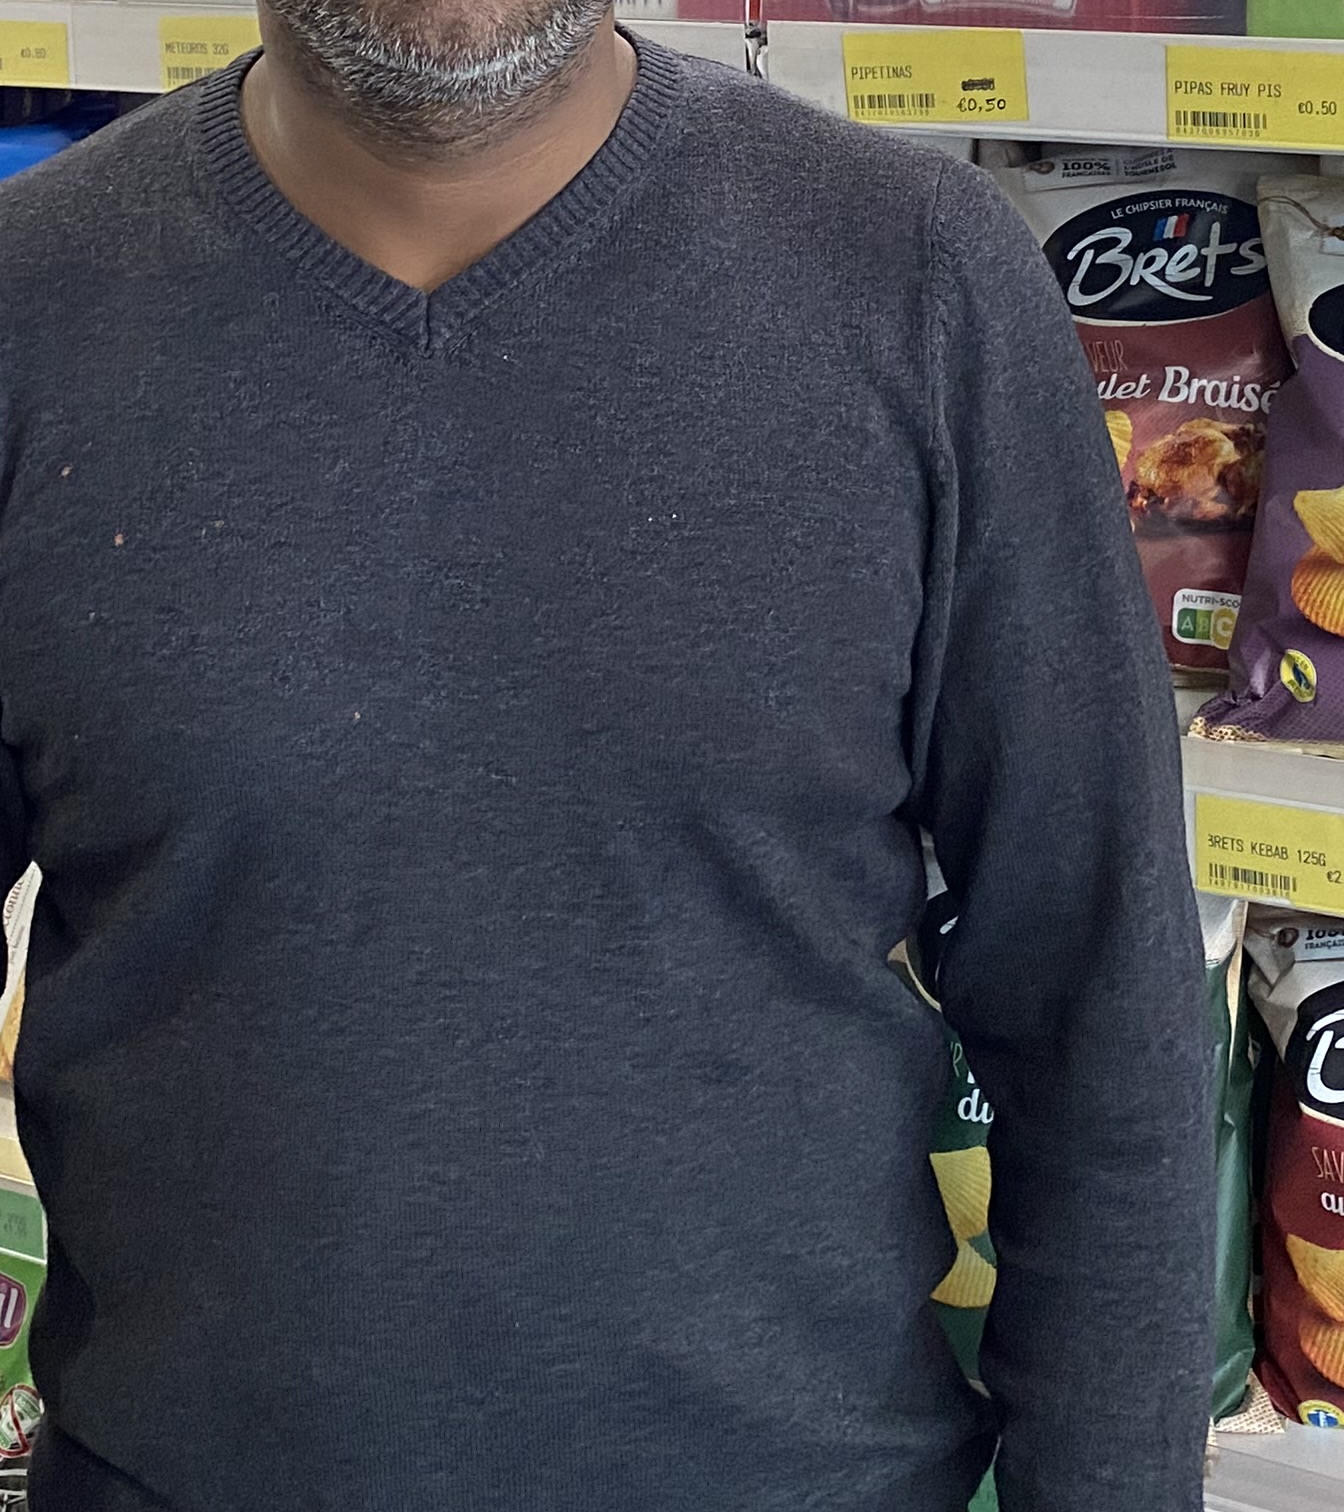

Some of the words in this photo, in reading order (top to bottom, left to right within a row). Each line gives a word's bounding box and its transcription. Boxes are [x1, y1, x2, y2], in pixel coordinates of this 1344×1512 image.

[851, 65, 913, 81] PIPETINAS
[1173, 80, 1213, 97] PIPAS
[1219, 83, 1251, 98] FRUY
[1257, 84, 1283, 99] PIS
[1297, 100, 1338, 118] €0.50
[1250, 840, 1290, 863] KEBAB
[1296, 848, 1328, 868] 125G
